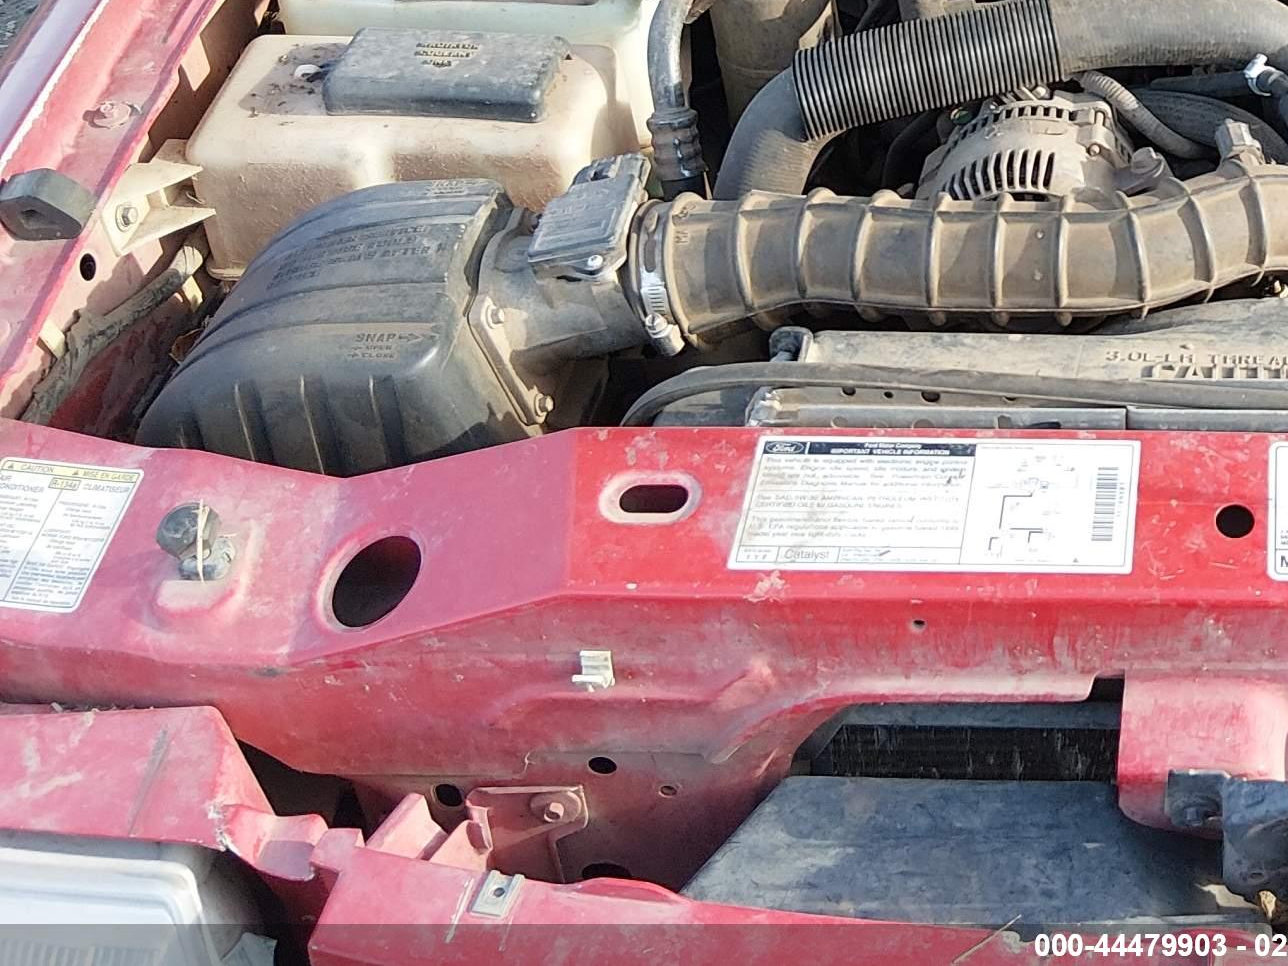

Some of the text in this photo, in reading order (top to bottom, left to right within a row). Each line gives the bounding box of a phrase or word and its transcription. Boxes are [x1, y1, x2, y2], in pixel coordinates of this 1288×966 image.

[355, 333, 396, 343] SNAP
[20, 463, 54, 474] CAUTION
[784, 547, 830, 560] Catalyst
